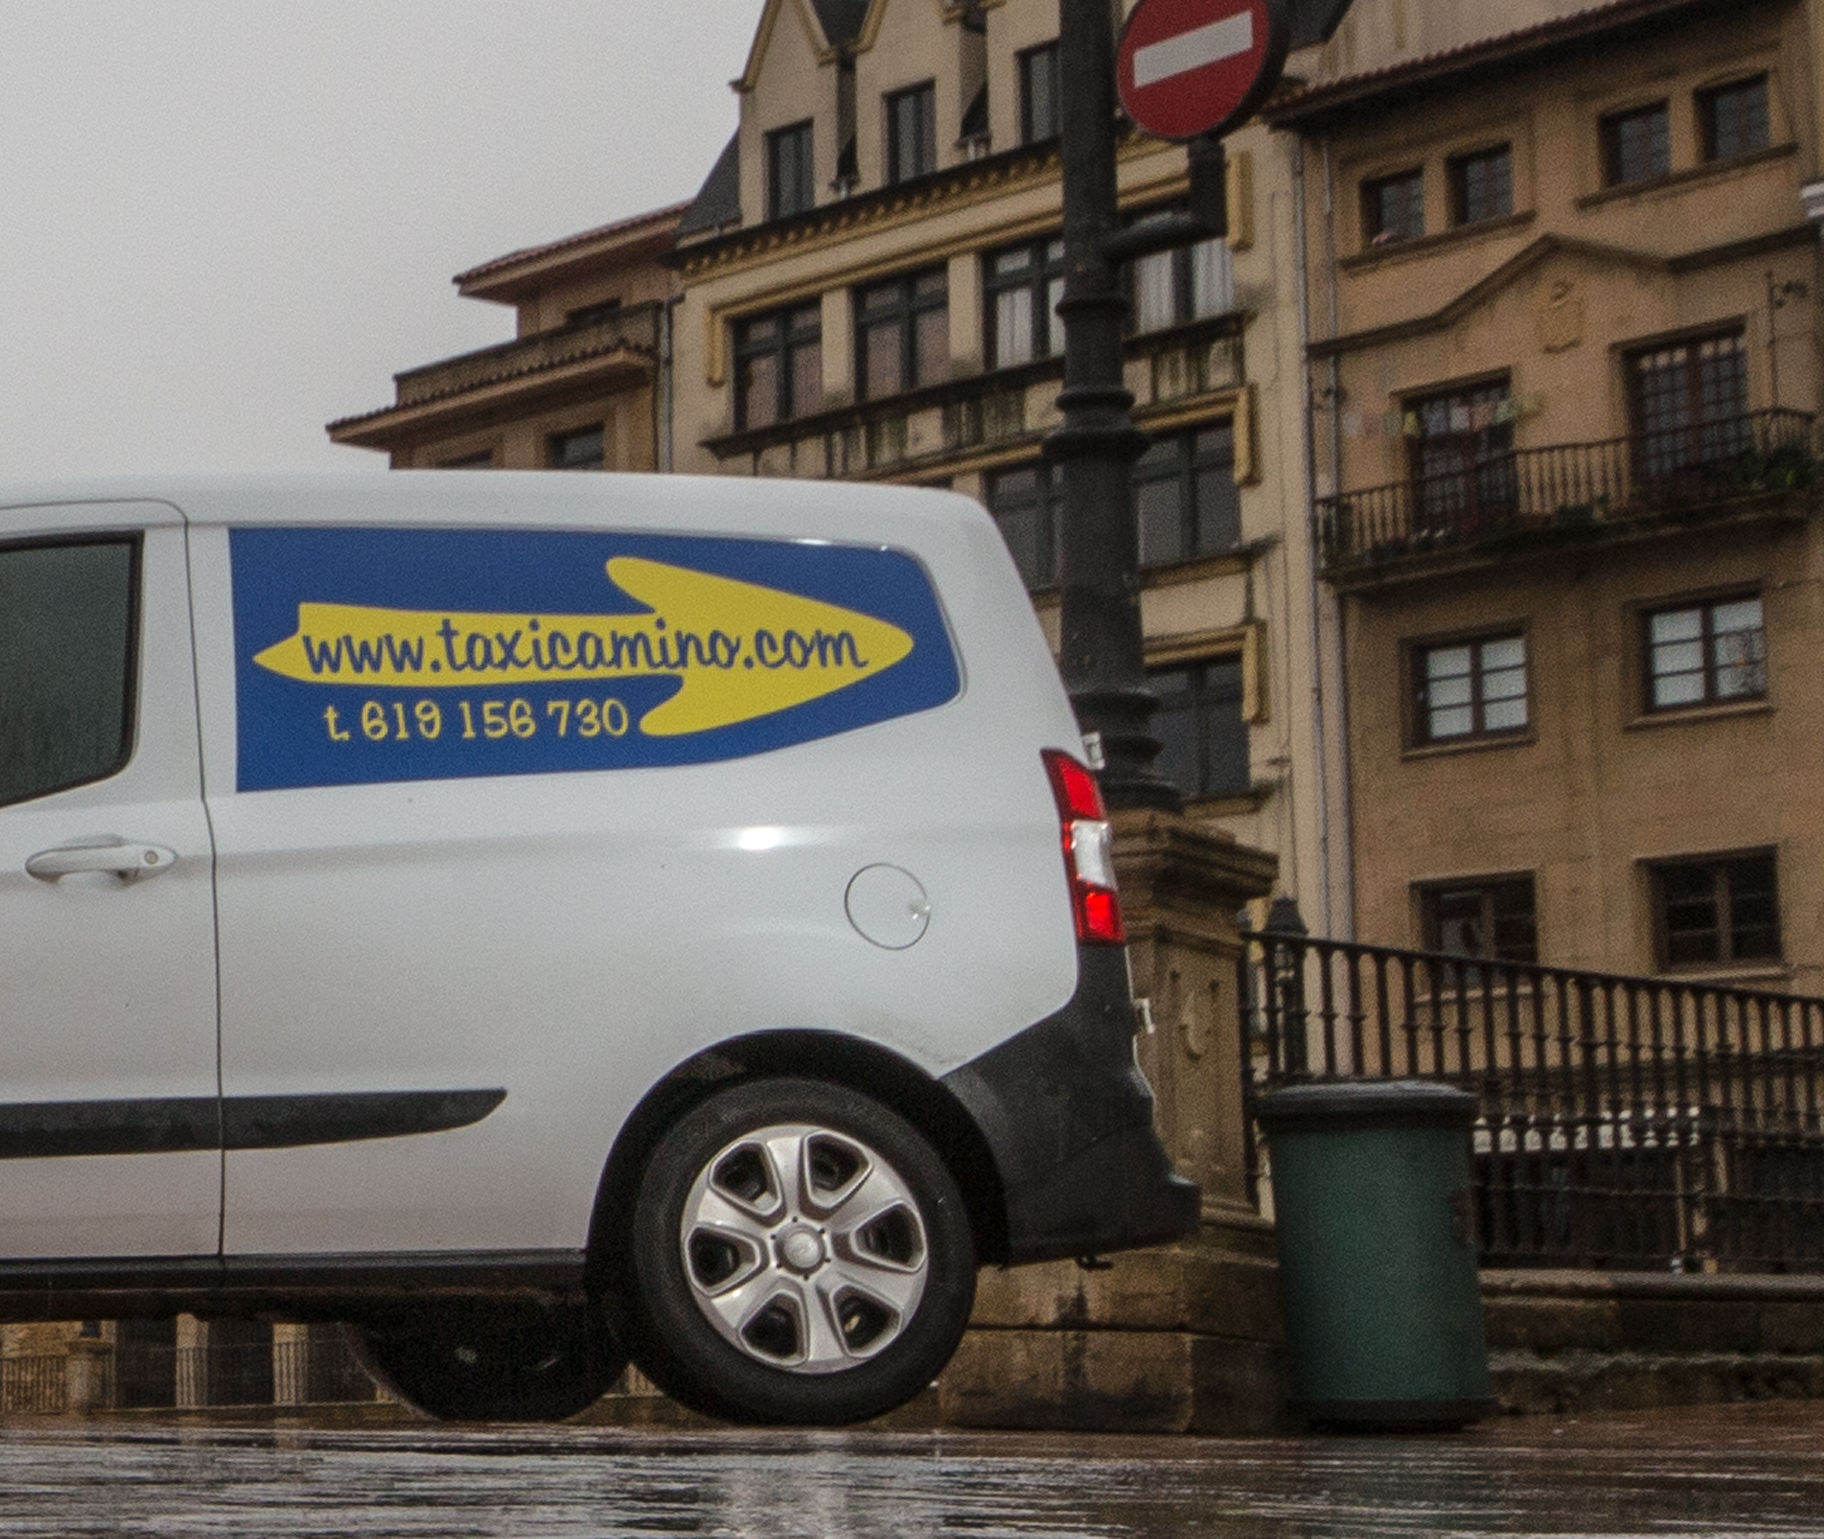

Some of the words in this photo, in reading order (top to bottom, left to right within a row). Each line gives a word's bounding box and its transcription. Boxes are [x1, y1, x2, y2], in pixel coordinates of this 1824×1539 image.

[302, 617, 869, 674] www.taxicamino.com
[361, 700, 442, 740] 619
[458, 697, 537, 739] 156
[546, 698, 630, 738] 730
